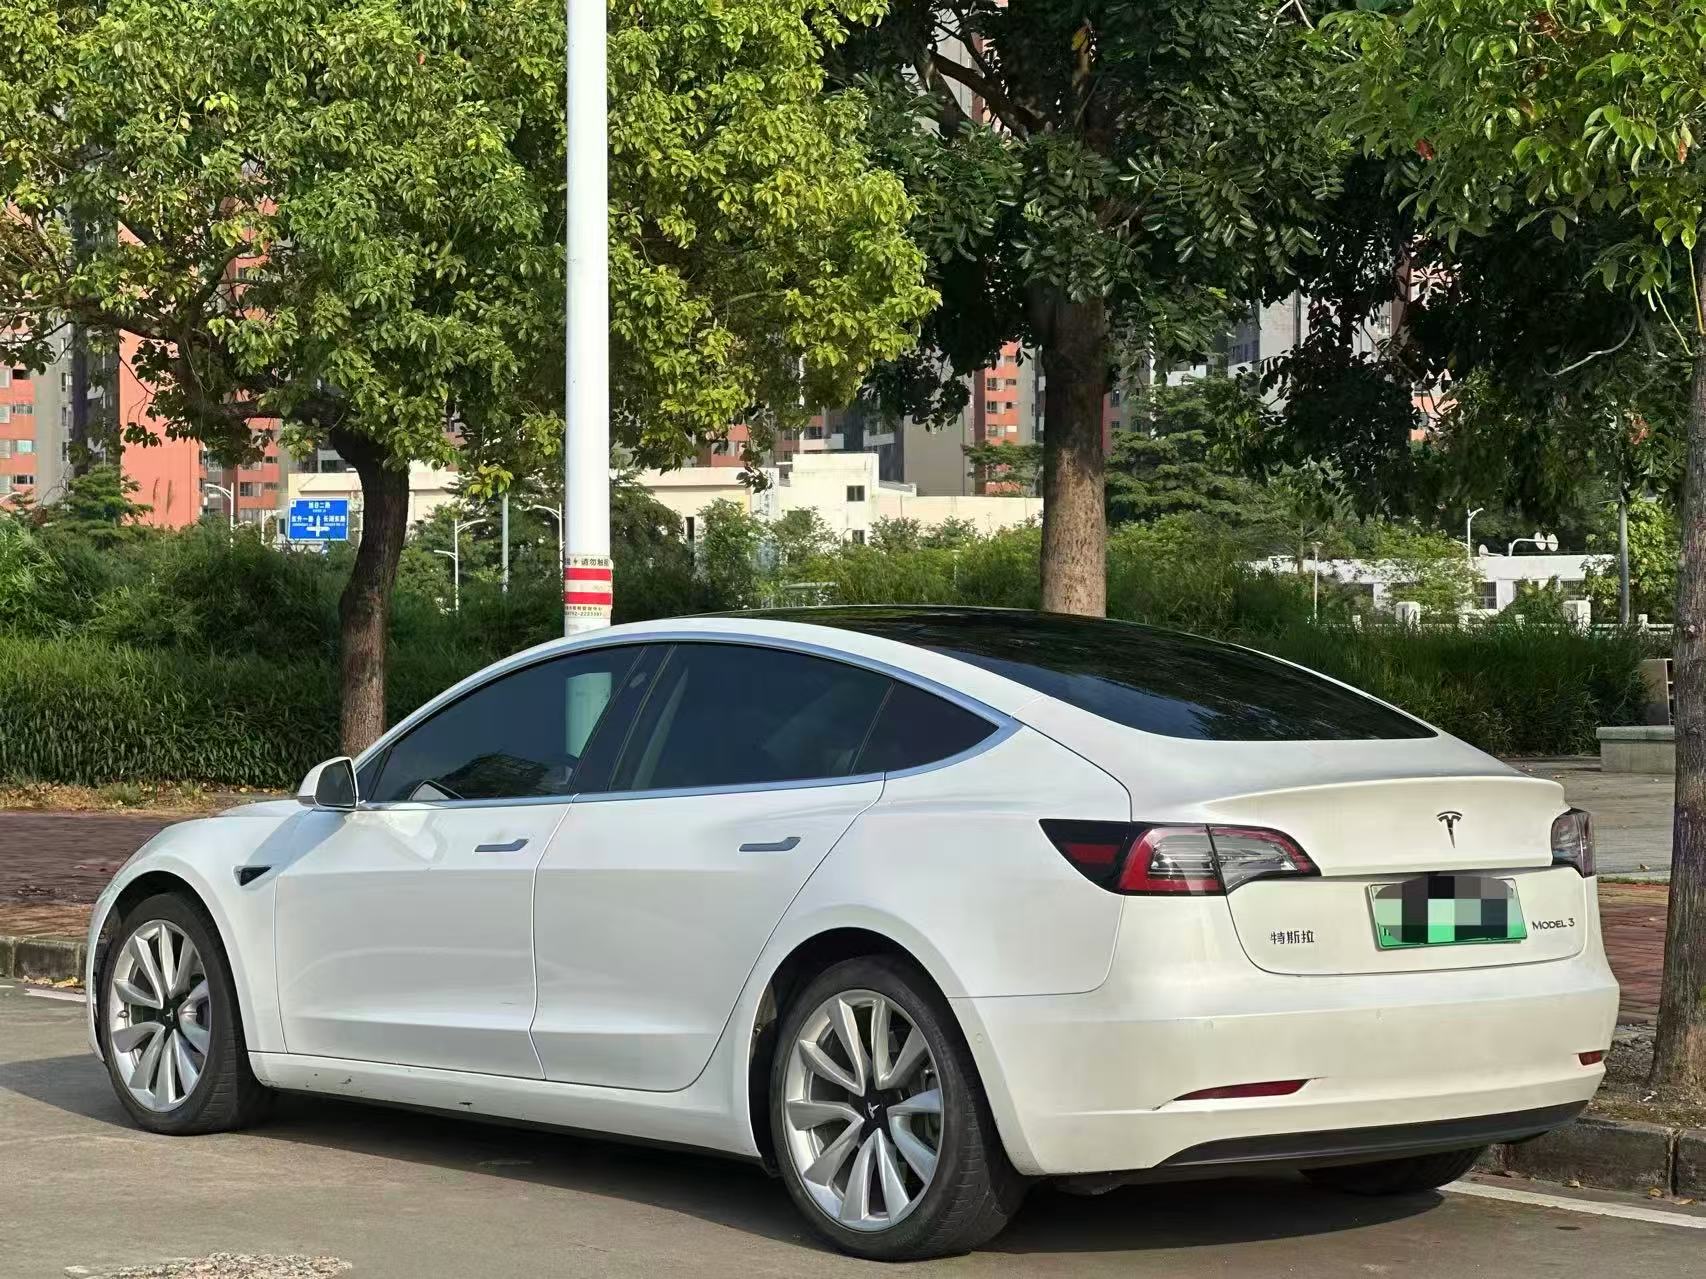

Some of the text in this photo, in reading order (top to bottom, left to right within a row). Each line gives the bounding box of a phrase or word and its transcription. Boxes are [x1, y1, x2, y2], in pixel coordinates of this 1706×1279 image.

[1531, 916, 1576, 931] MODEL 3
[1269, 929, 1315, 945] 特斯拉
